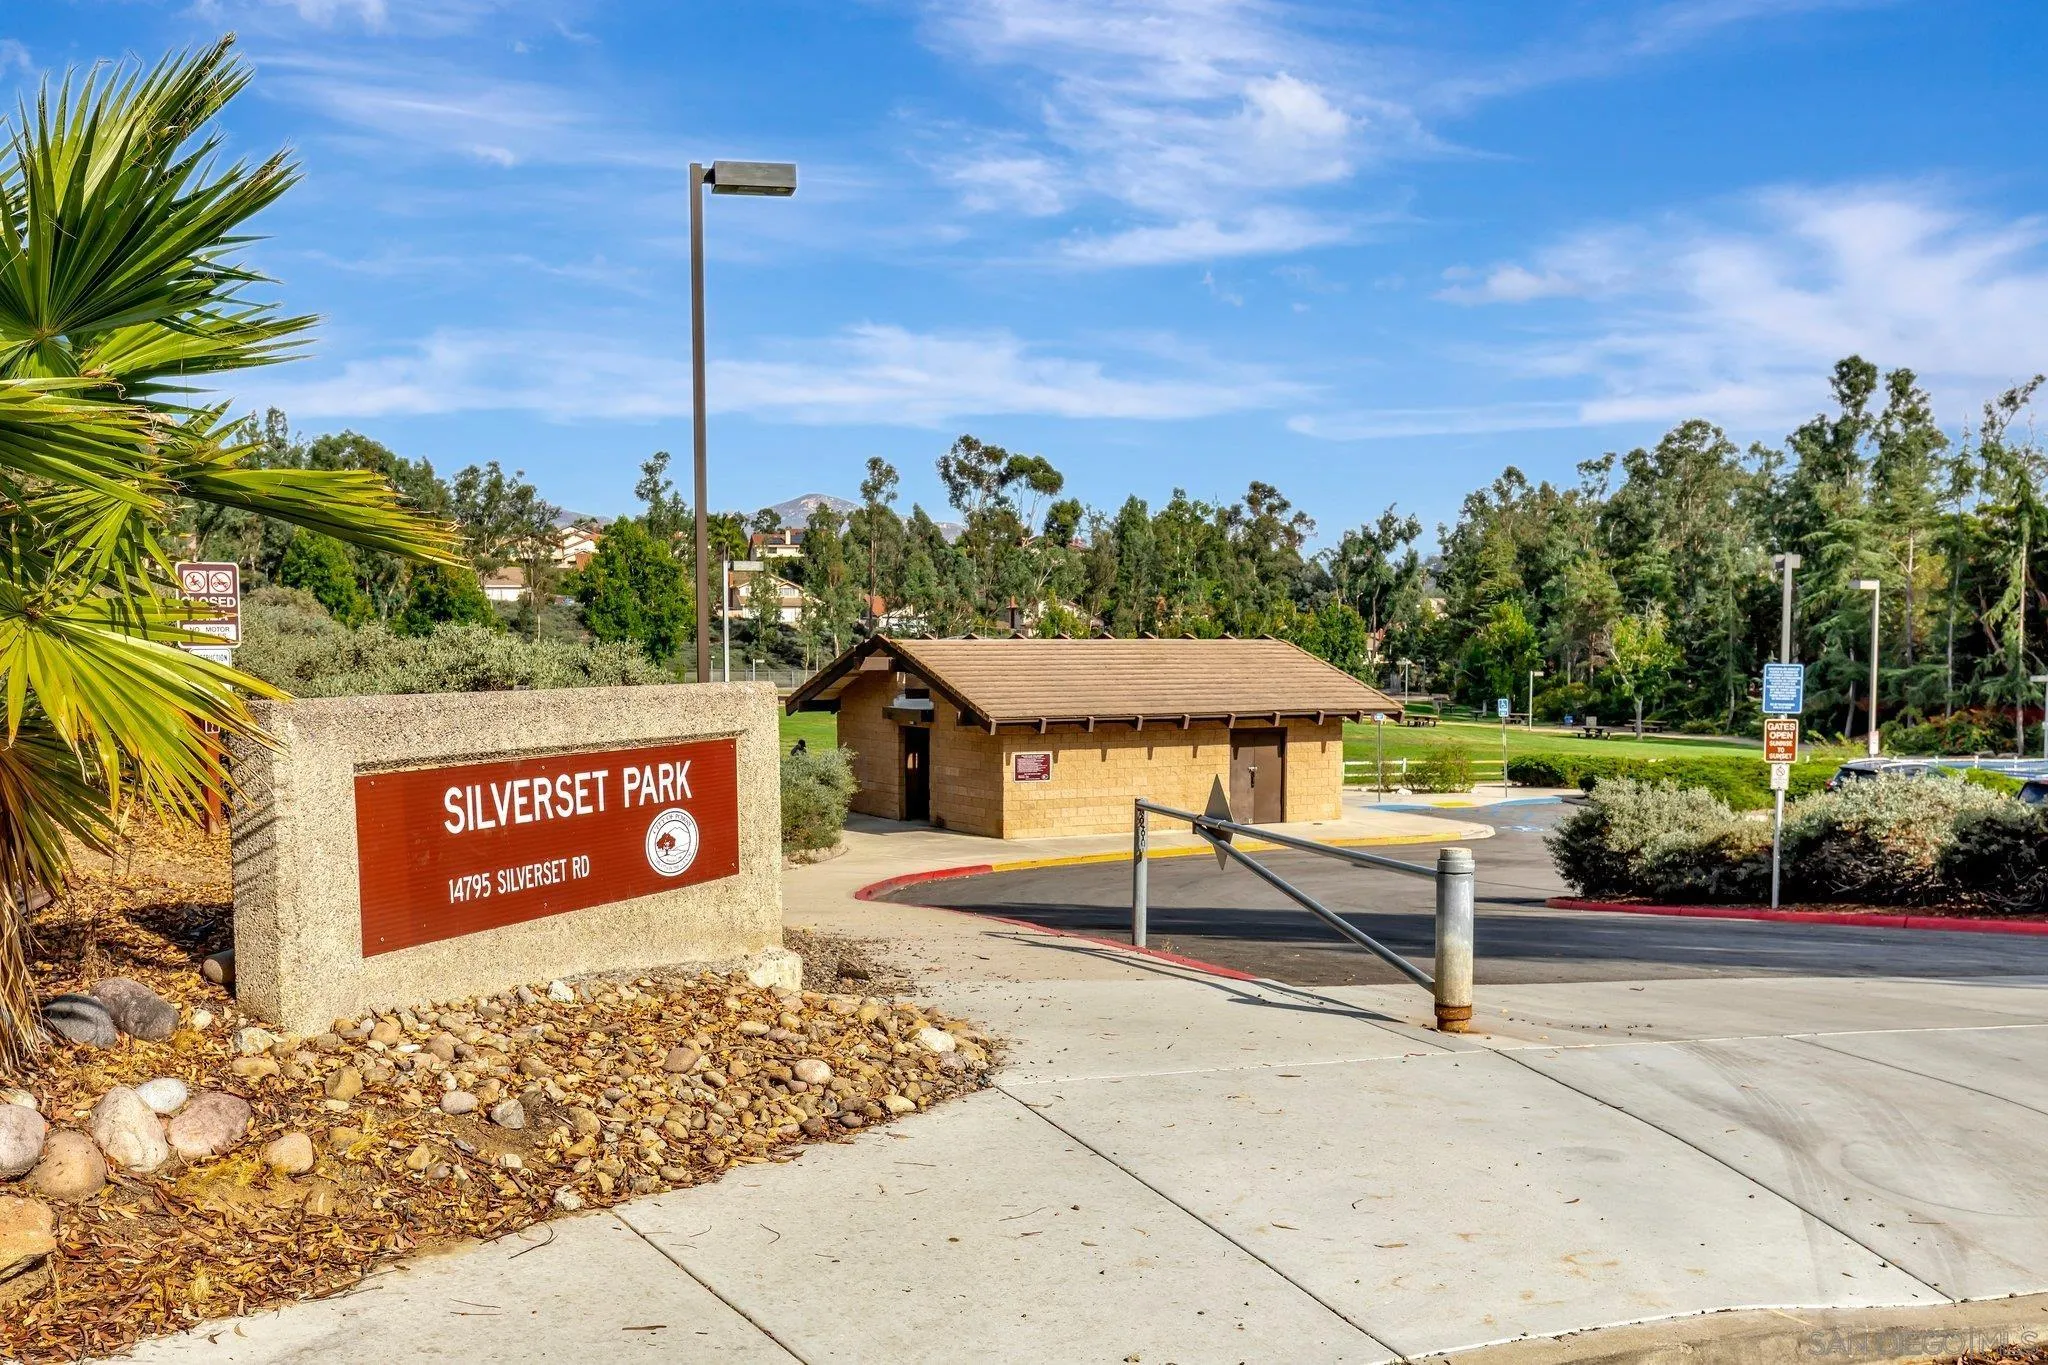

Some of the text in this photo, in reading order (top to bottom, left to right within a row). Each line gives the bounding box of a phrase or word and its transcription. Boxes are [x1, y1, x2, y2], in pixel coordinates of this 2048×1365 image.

[1767, 722, 1796, 731] GATES
[1769, 731, 1794, 739] OPEN
[444, 760, 692, 834] SILVERSET PARK
[449, 855, 590, 904] 14795 SILVERSET RD
